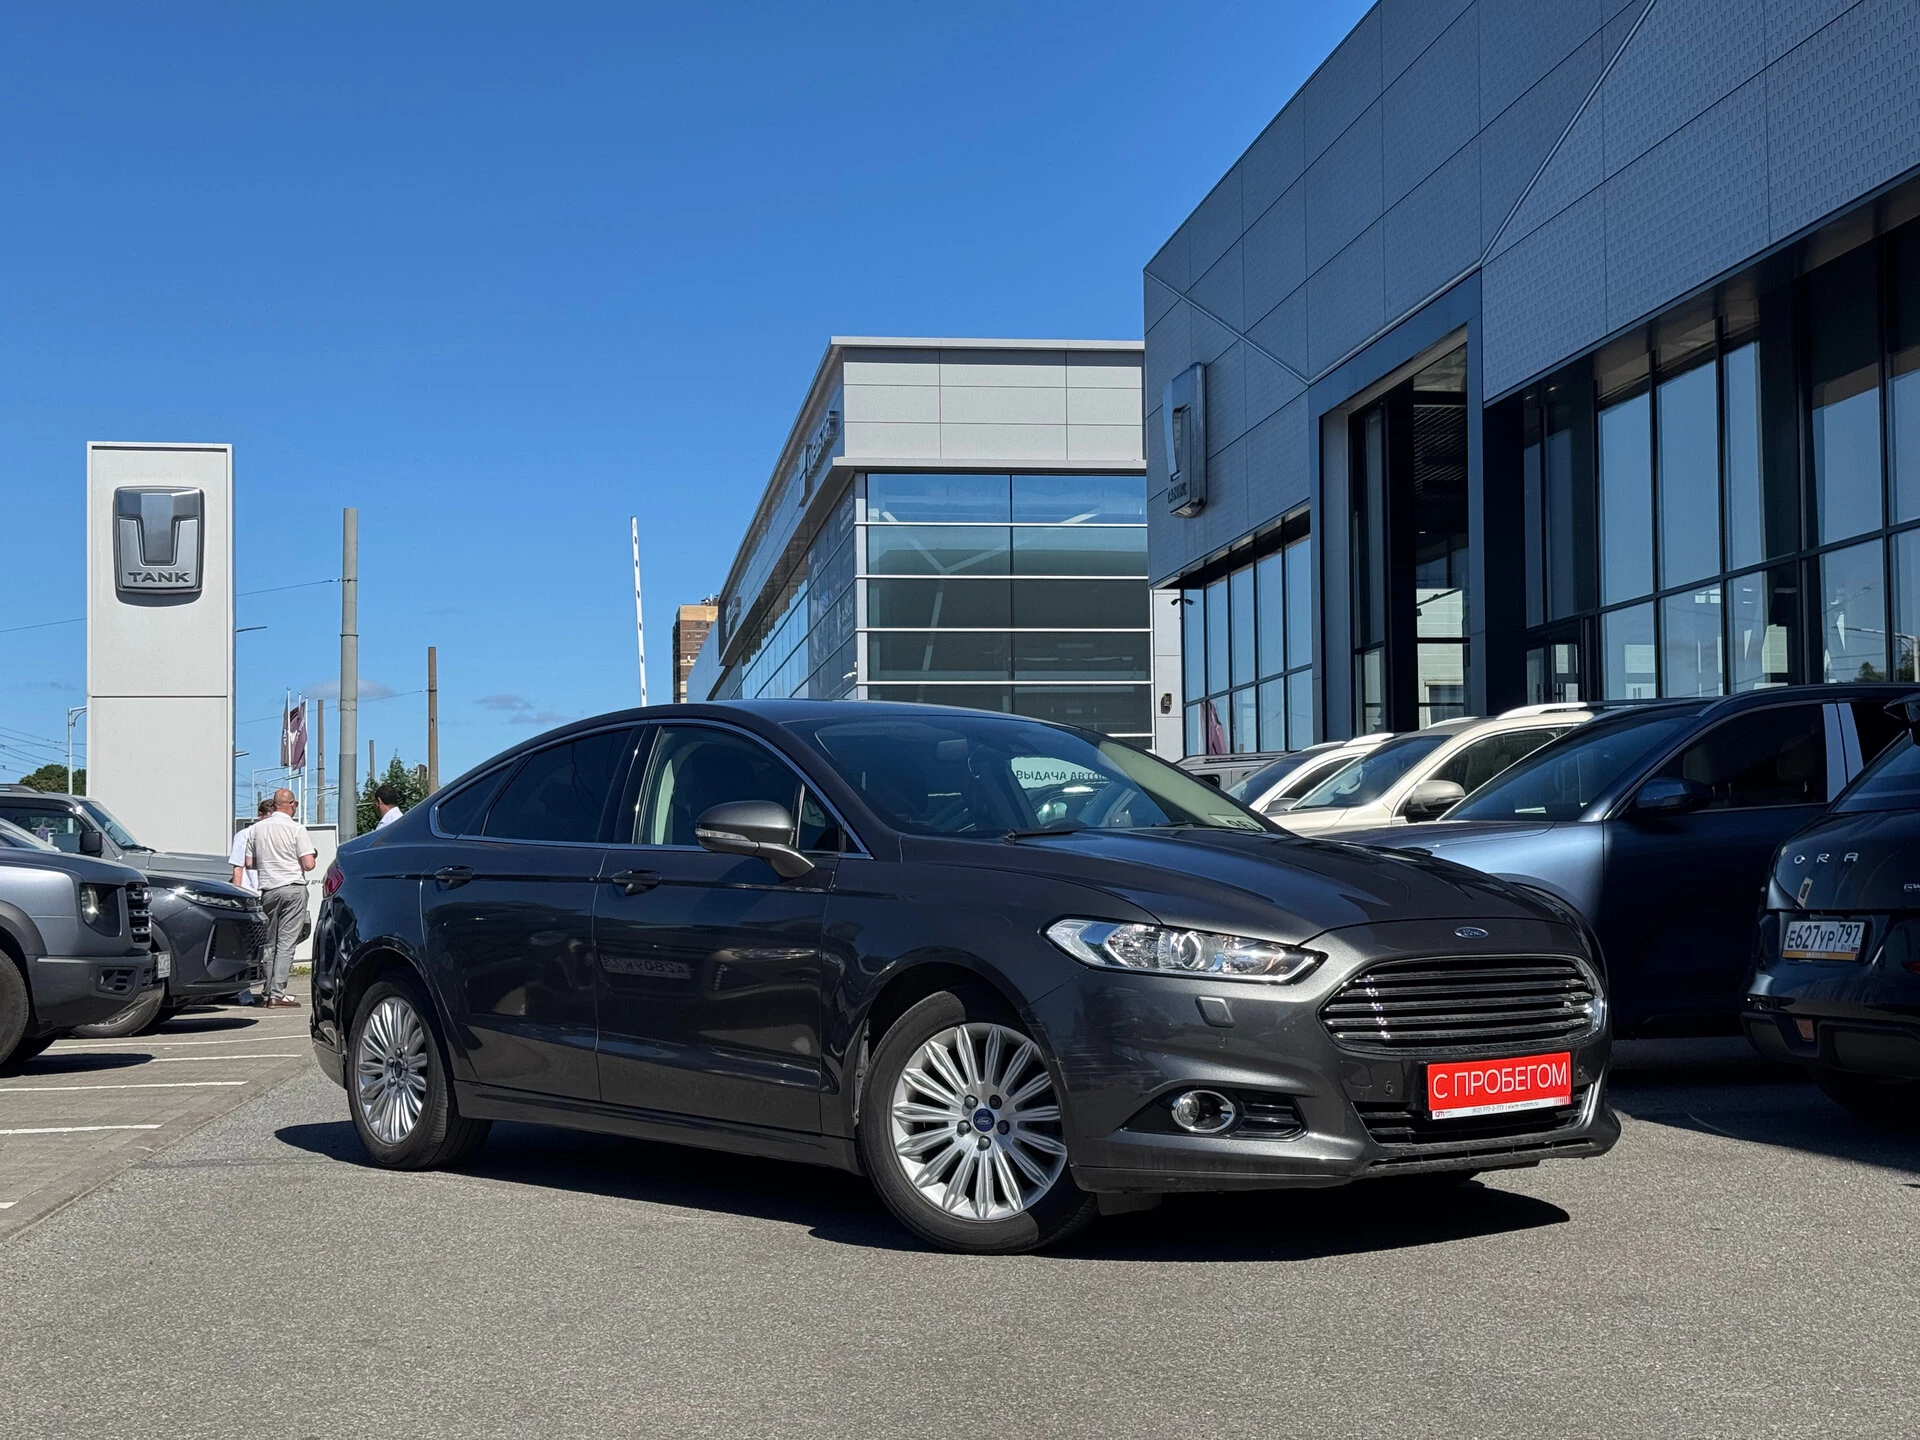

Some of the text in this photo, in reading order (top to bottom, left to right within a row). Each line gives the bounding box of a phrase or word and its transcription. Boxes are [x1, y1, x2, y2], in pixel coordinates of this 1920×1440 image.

[127, 571, 190, 583] TANK
[1015, 770, 1067, 782] ВЫДАЧА
[1793, 852, 1859, 864] ORA
[1433, 1061, 1567, 1099] С ПРОБЕГОМ
